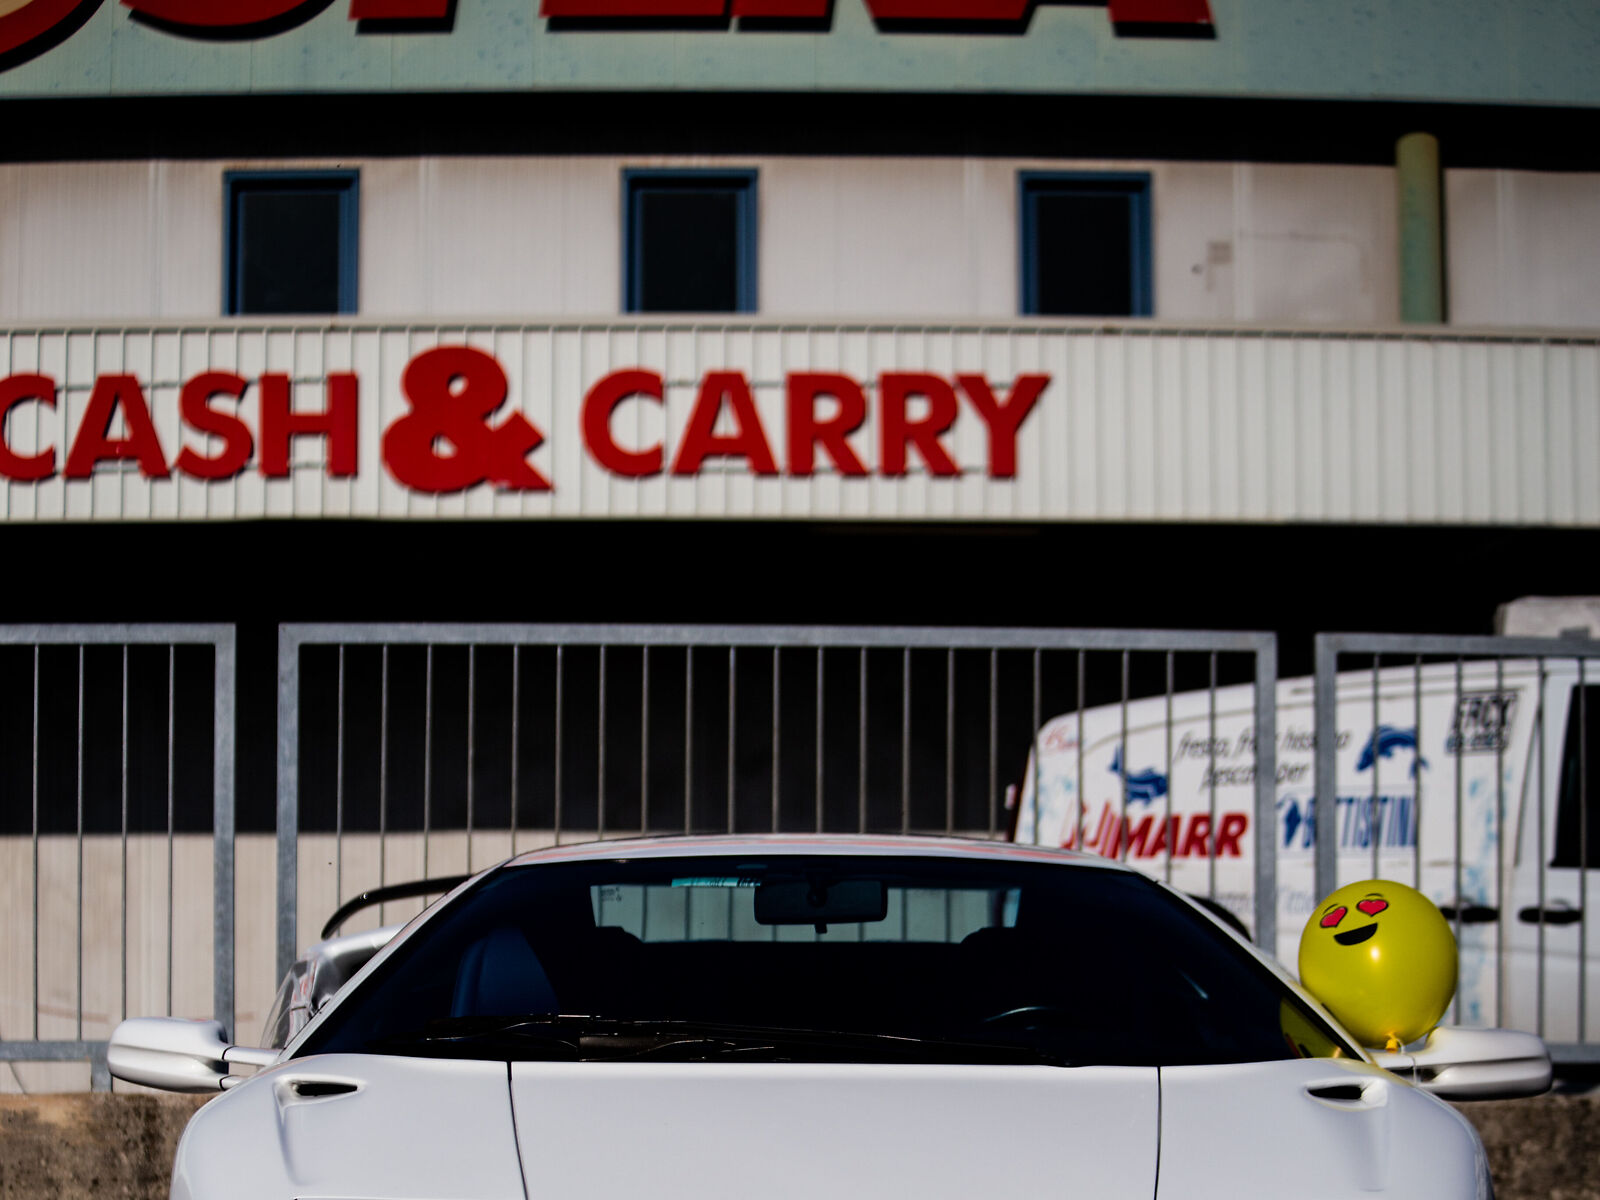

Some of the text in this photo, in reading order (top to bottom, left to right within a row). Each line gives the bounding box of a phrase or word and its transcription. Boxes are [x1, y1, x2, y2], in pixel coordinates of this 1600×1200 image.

[0, 344, 1052, 494] CASH & CARRY
